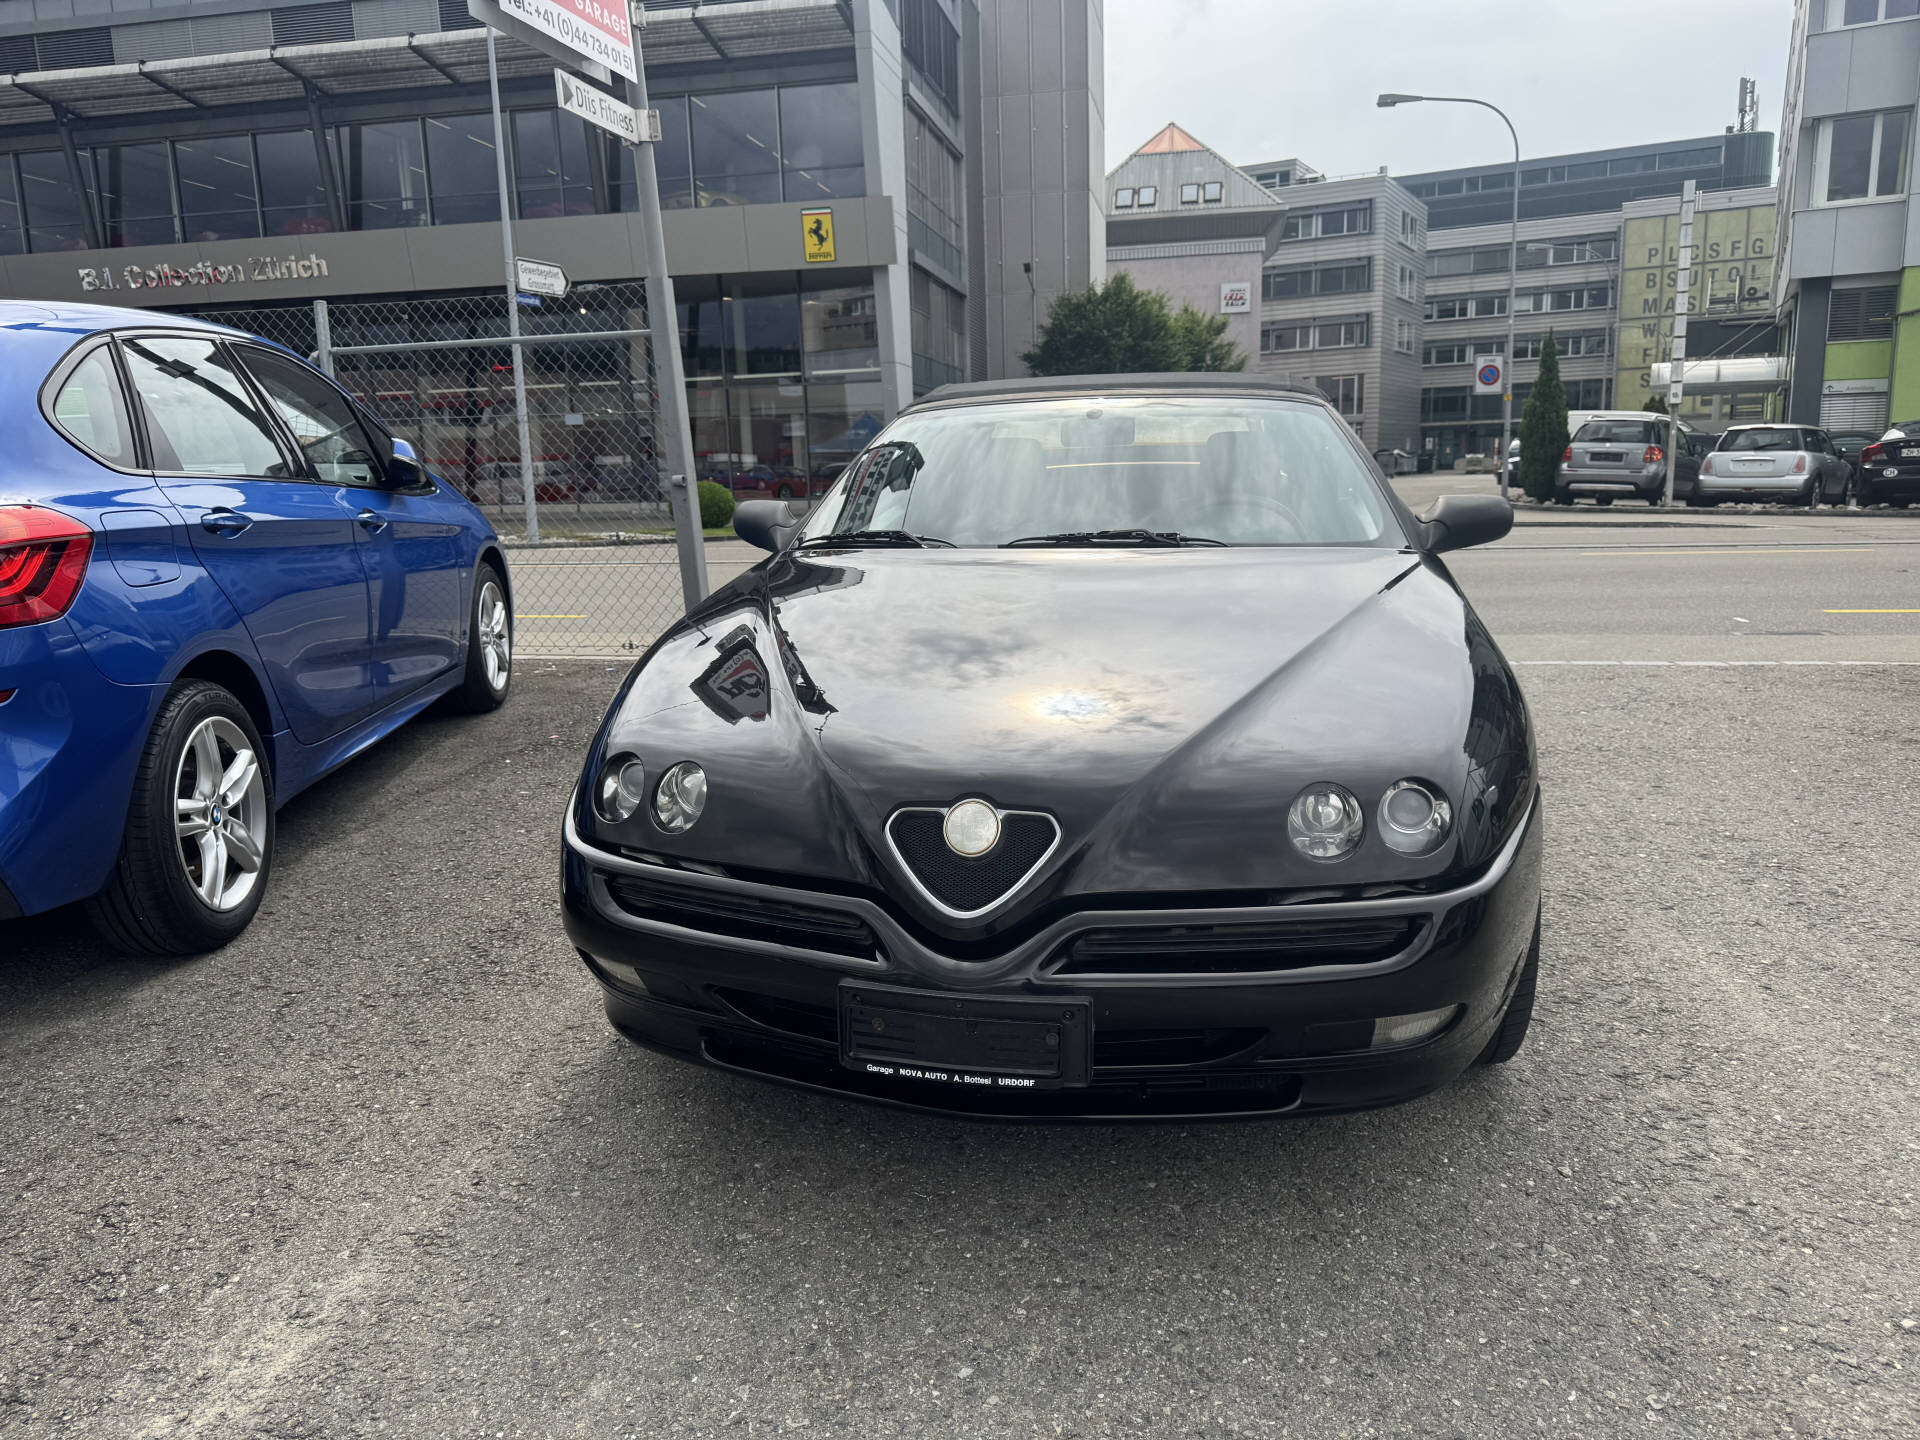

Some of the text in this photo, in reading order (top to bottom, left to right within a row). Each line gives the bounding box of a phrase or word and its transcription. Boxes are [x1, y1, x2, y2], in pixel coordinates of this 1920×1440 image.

[575, 0, 628, 38] GARAGE
[575, 85, 634, 134] Diis Fitness
[123, 260, 246, 289] Collection
[248, 254, 329, 281] Zürich
[808, 252, 832, 260] Ferrari
[866, 1063, 893, 1075] Garage
[899, 1068, 923, 1078] NOVA
[924, 1071, 948, 1081] AUTO
[953, 1074, 962, 1083] A.
[998, 1077, 1036, 1087] URDORF
